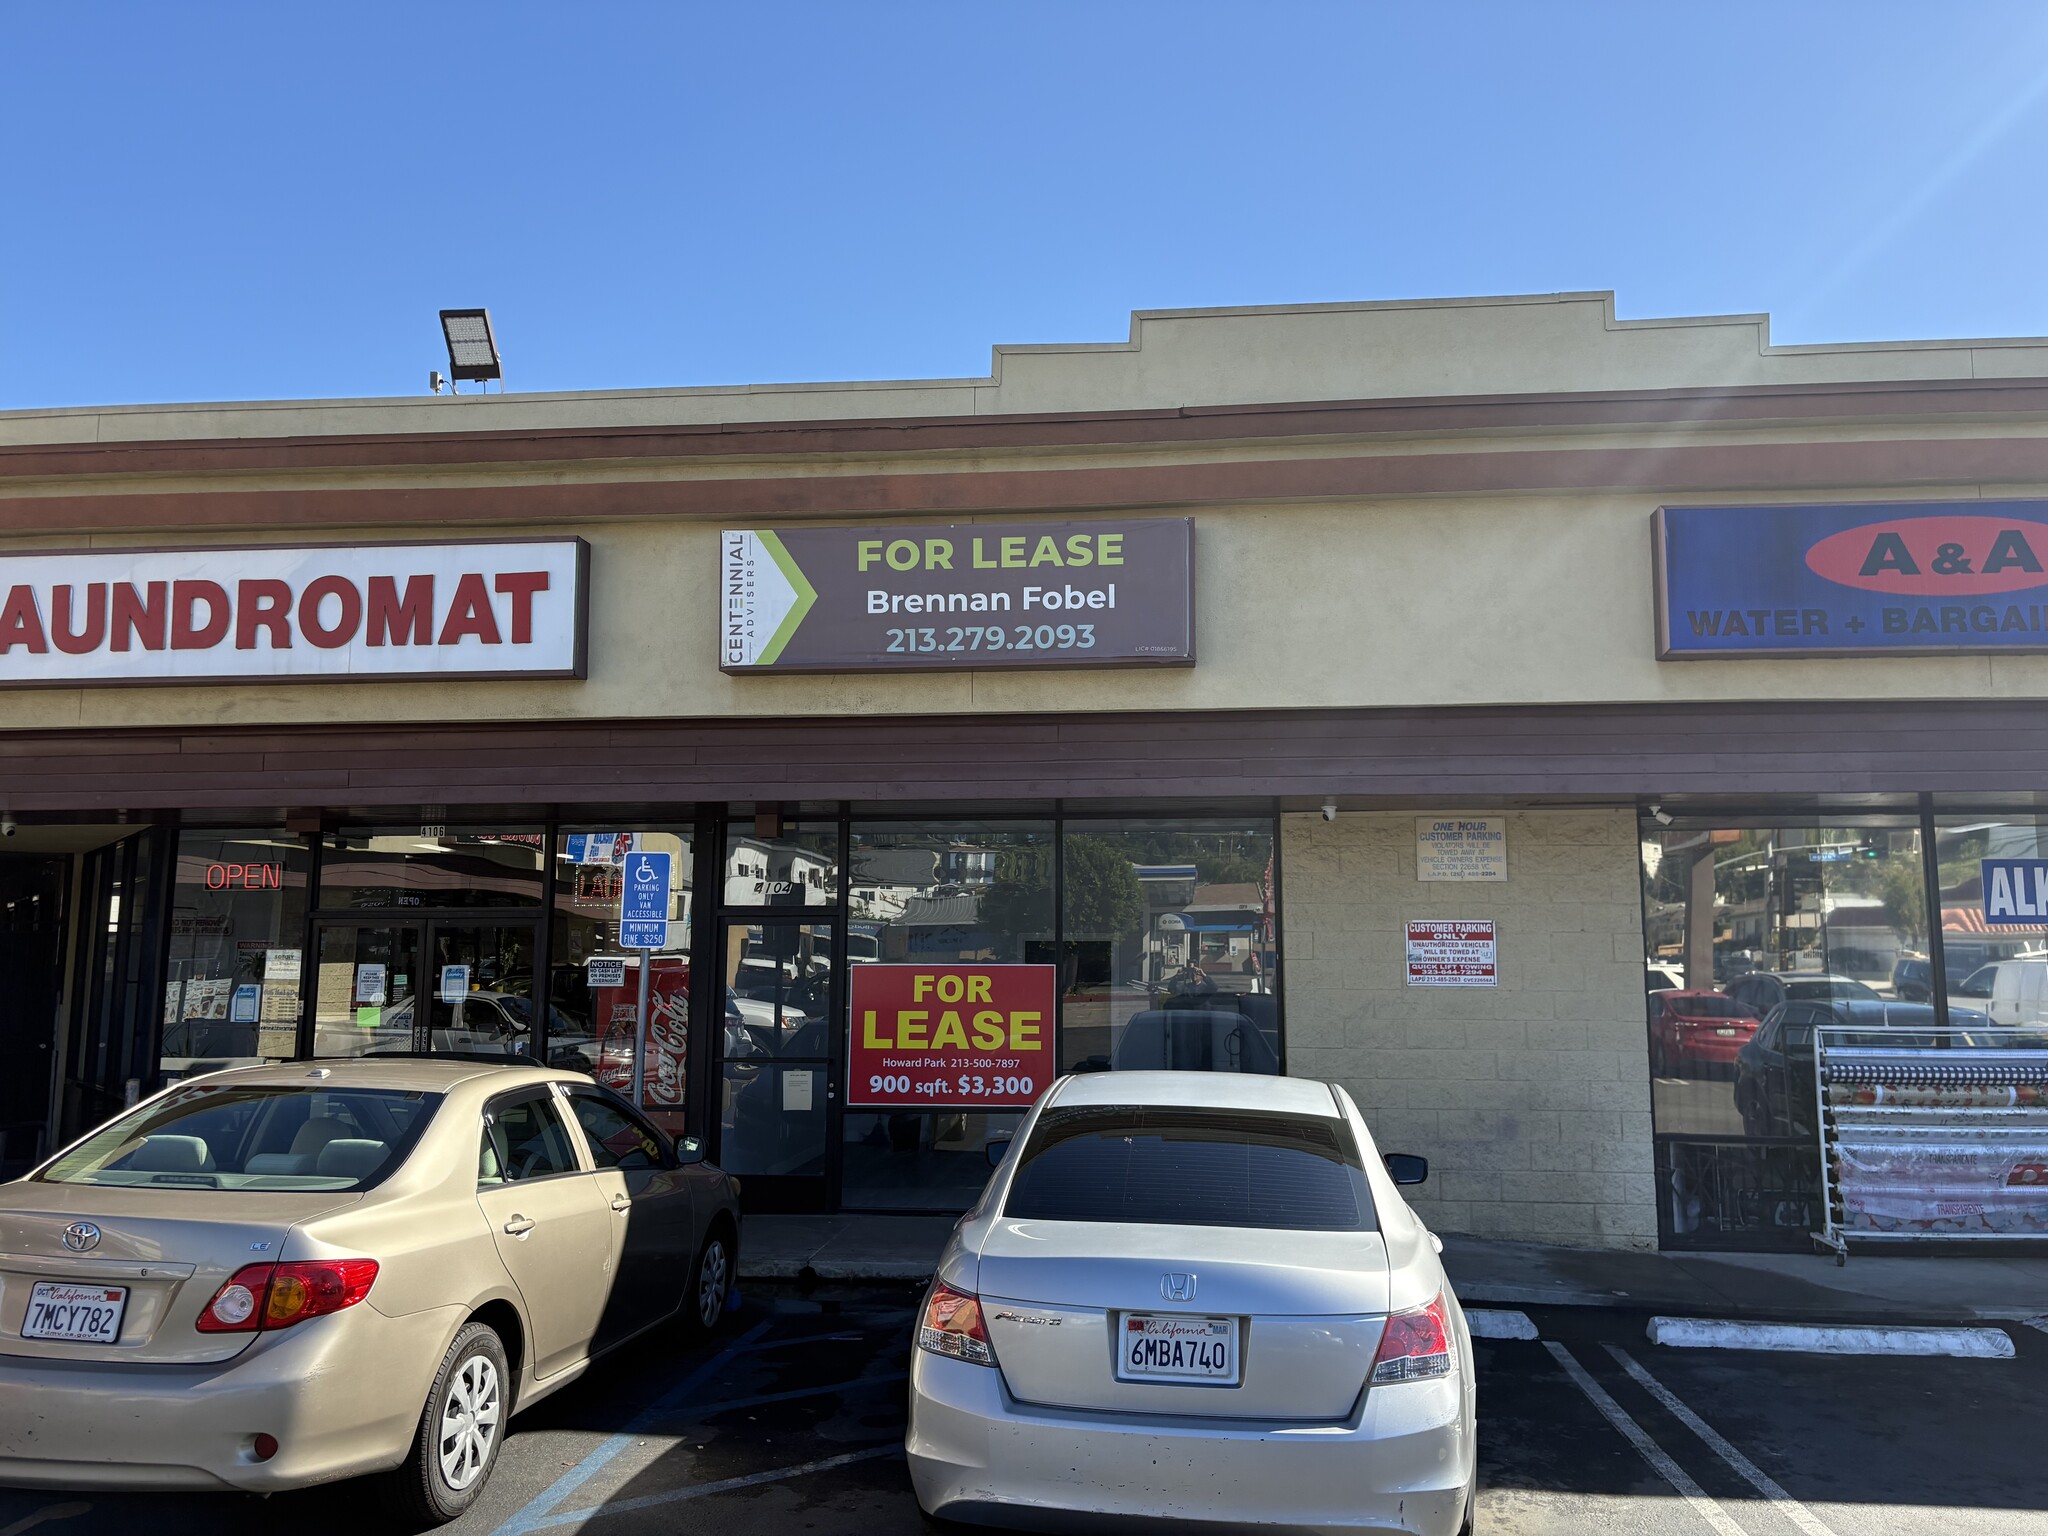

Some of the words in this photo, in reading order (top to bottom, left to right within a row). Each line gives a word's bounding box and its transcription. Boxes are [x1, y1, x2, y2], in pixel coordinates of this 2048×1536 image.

[857, 538, 954, 572] FOR
[972, 533, 1124, 569] LEASE
[1858, 532, 1921, 576] A
[1930, 543, 1975, 575] &
[1980, 529, 2044, 574] A
[729, 534, 743, 663] CENTENNIAL
[746, 560, 755, 638] ADVISERS
[867, 586, 1012, 615] Brennan
[1023, 584, 1116, 611] Fobel
[0, 571, 549, 654] AUNDROMAT
[1686, 608, 1829, 637] WATER
[1845, 615, 1865, 634] +
[1882, 604, 2048, 634] BARGAI
[885, 623, 1096, 653] 213.279.2093
[421, 826, 445, 837] 4106
[1432, 822, 1454, 831] ONE
[1458, 822, 1487, 831] HOUR
[1419, 831, 1463, 841] CUSTOMER
[1467, 831, 1502, 841] PARKING
[207, 864, 280, 889] OPEN
[634, 883, 660, 892] PARKING
[638, 892, 654, 900] ONLY
[754, 882, 793, 894] 4104
[640, 901, 651, 909] VAN
[627, 910, 663, 919] ACCESSIBLE
[629, 923, 659, 933] MINIMUM
[1409, 923, 1454, 933] CUSTOMER
[1456, 923, 1492, 933] PARKING
[624, 934, 638, 944] FINE
[643, 934, 663, 944] $250
[913, 974, 993, 1003] FOR
[863, 1010, 1042, 1051] LEASE
[882, 1057, 922, 1068] Howard
[924, 1058, 947, 1068] Park
[950, 1058, 1020, 1069] 213-500-7897
[869, 1075, 911, 1094] 900
[915, 1078, 953, 1097] sqft.
[958, 1074, 1033, 1097] $3,300
[1928, 1154, 1978, 1165] TRANSPARENTE
[1936, 1203, 1984, 1215] TRANSPARENTE
[37, 1288, 49, 1296] OCT
[50, 1287, 105, 1304] California
[32, 1303, 114, 1334] 7MCY782
[1147, 1320, 1213, 1339] California
[1131, 1338, 1225, 1370] 6MBA740
